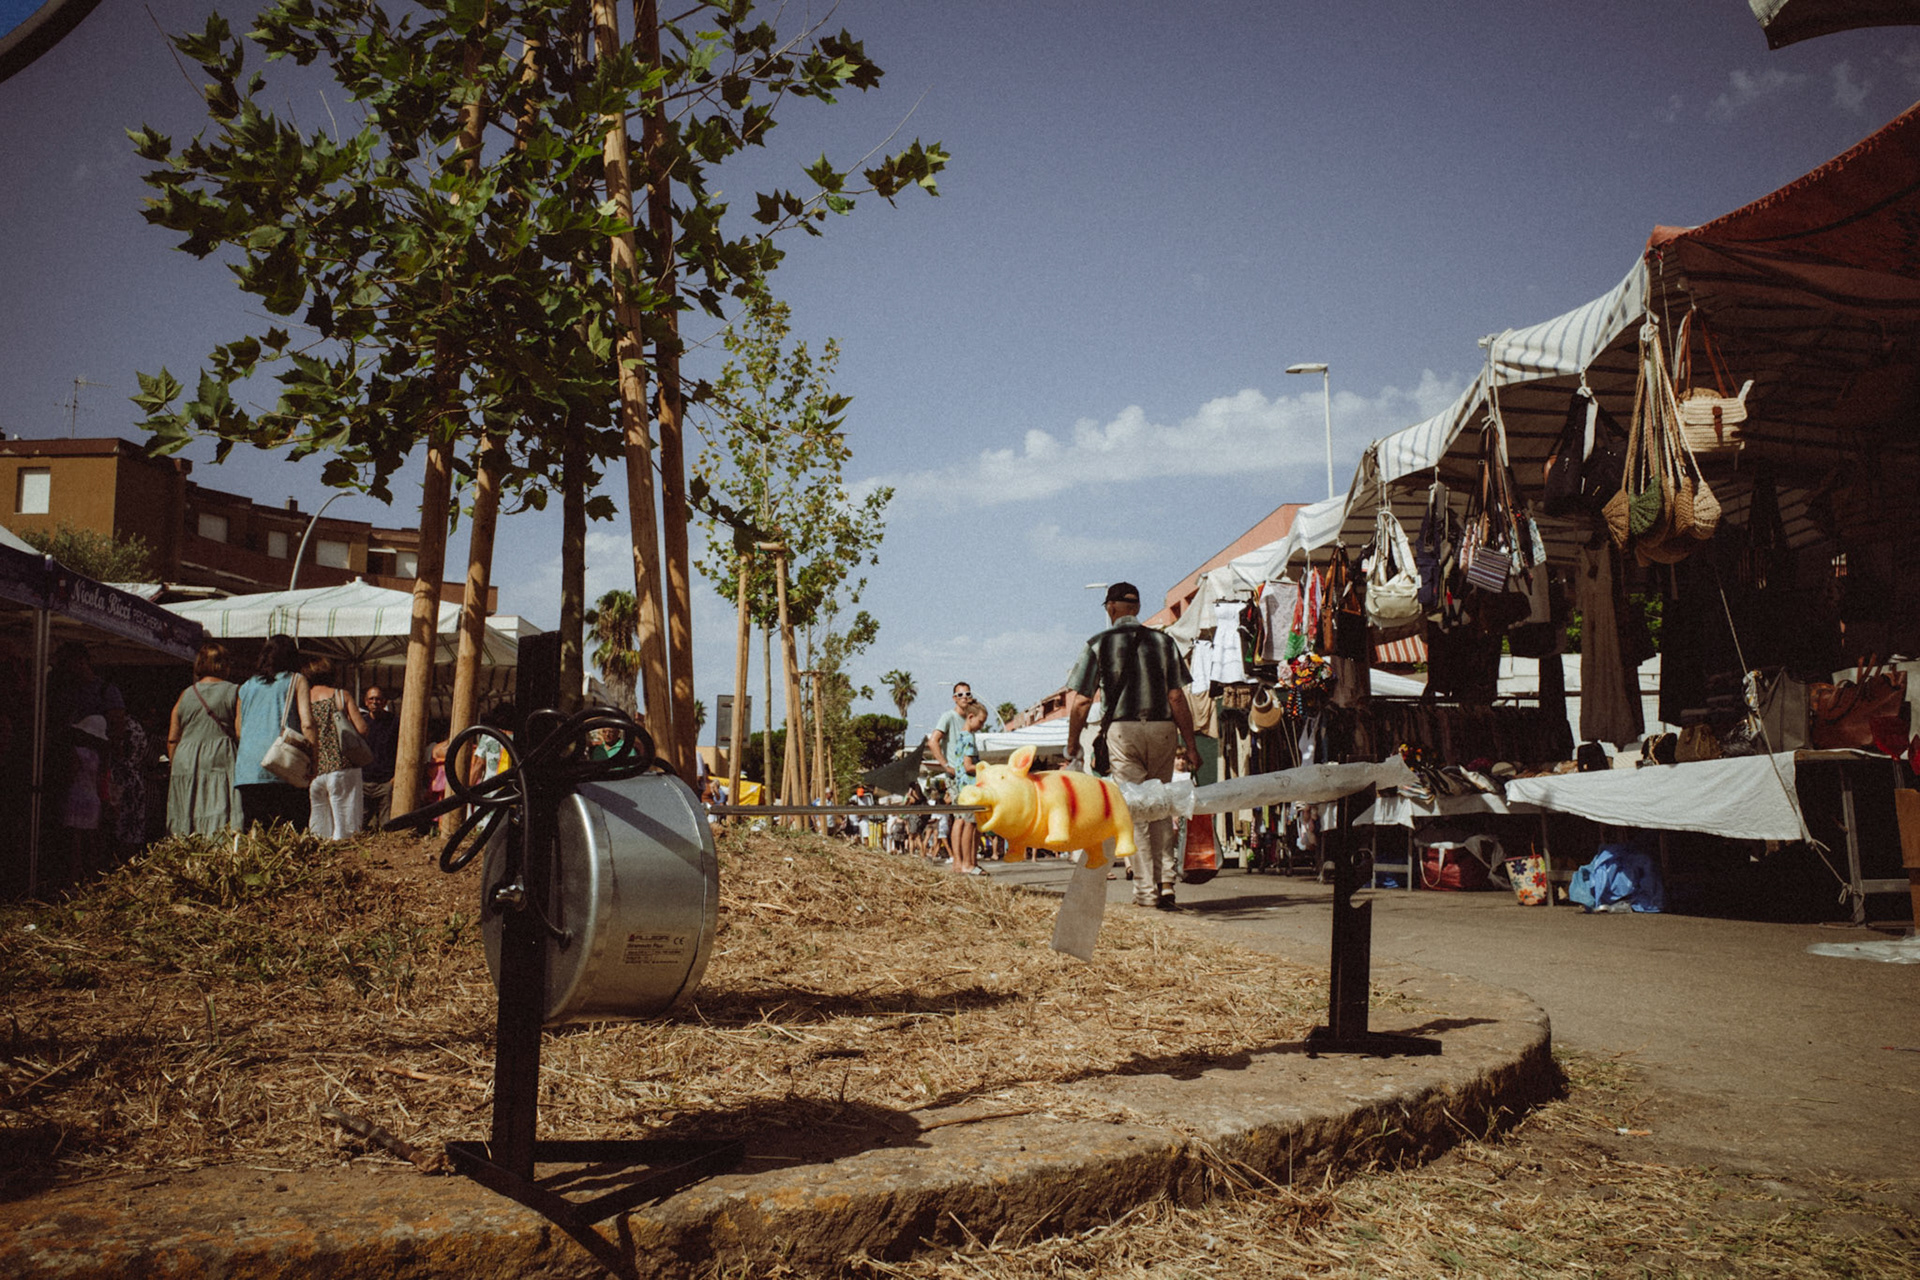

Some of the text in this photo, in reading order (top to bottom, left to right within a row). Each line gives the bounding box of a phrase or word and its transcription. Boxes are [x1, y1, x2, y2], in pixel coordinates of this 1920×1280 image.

[71, 579, 163, 631] Nicola Ricci PESCHERIA
